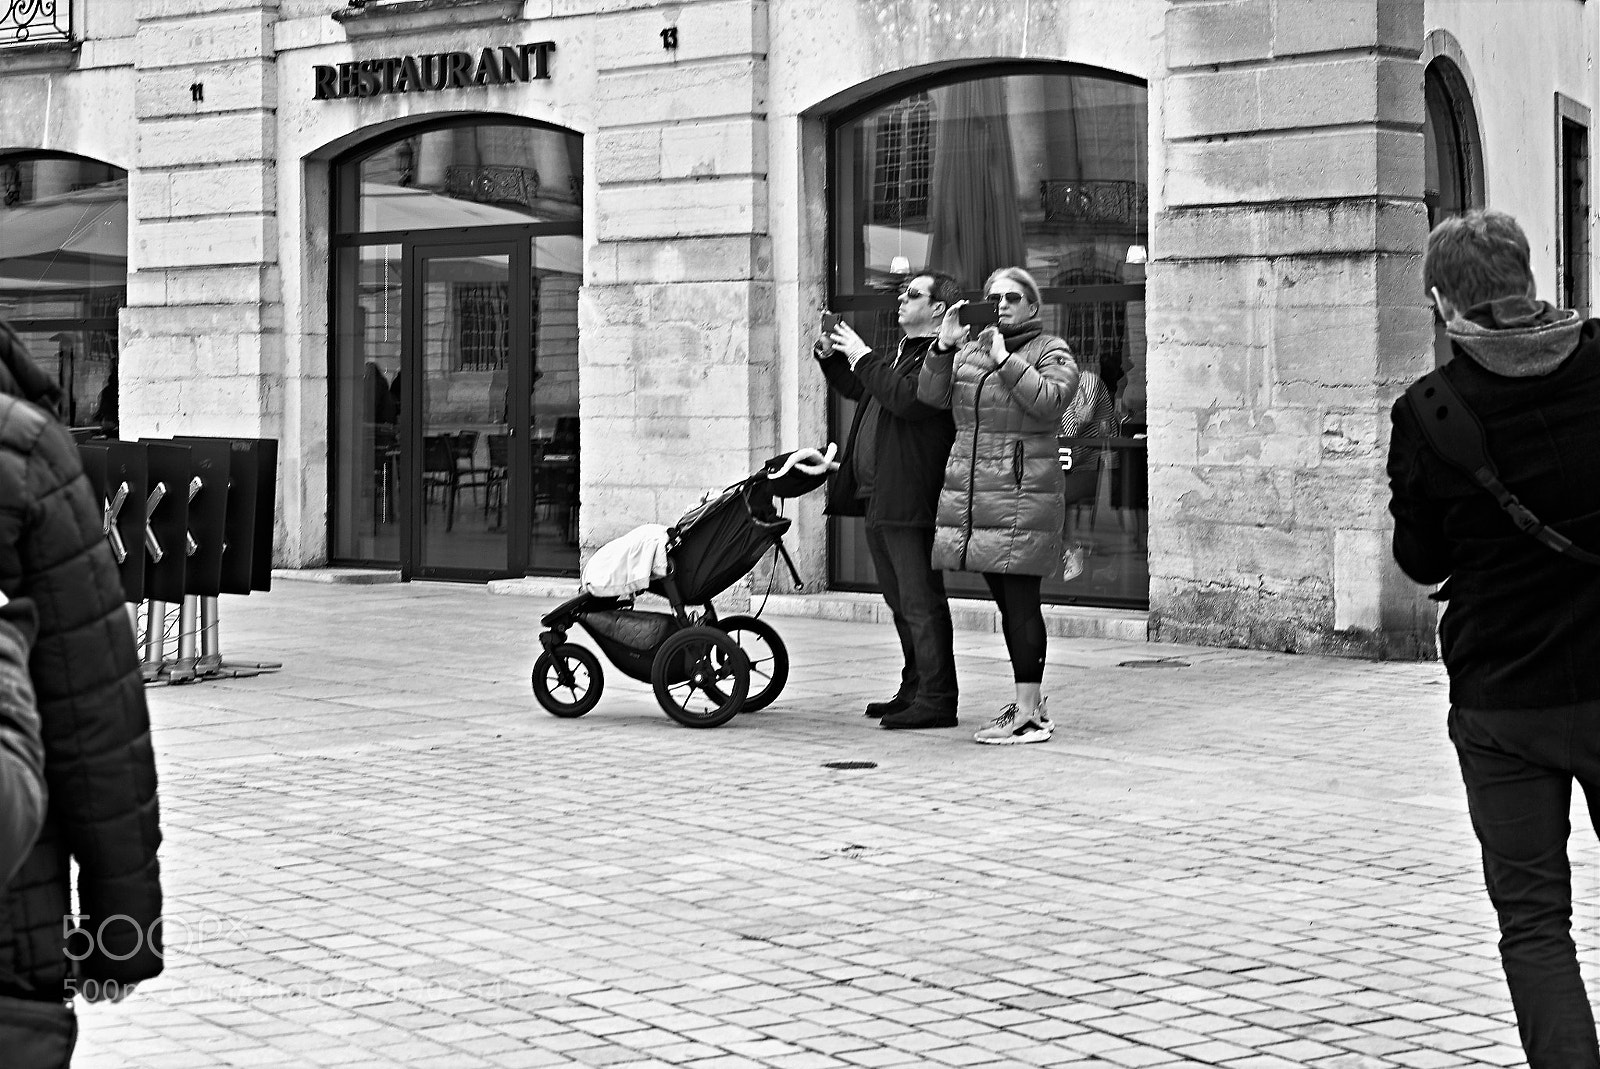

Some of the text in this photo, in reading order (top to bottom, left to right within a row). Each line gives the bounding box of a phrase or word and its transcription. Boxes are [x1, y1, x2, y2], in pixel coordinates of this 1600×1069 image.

[659, 27, 678, 51] 13
[312, 41, 556, 100] RESTAURANT
[189, 82, 204, 102] 11
